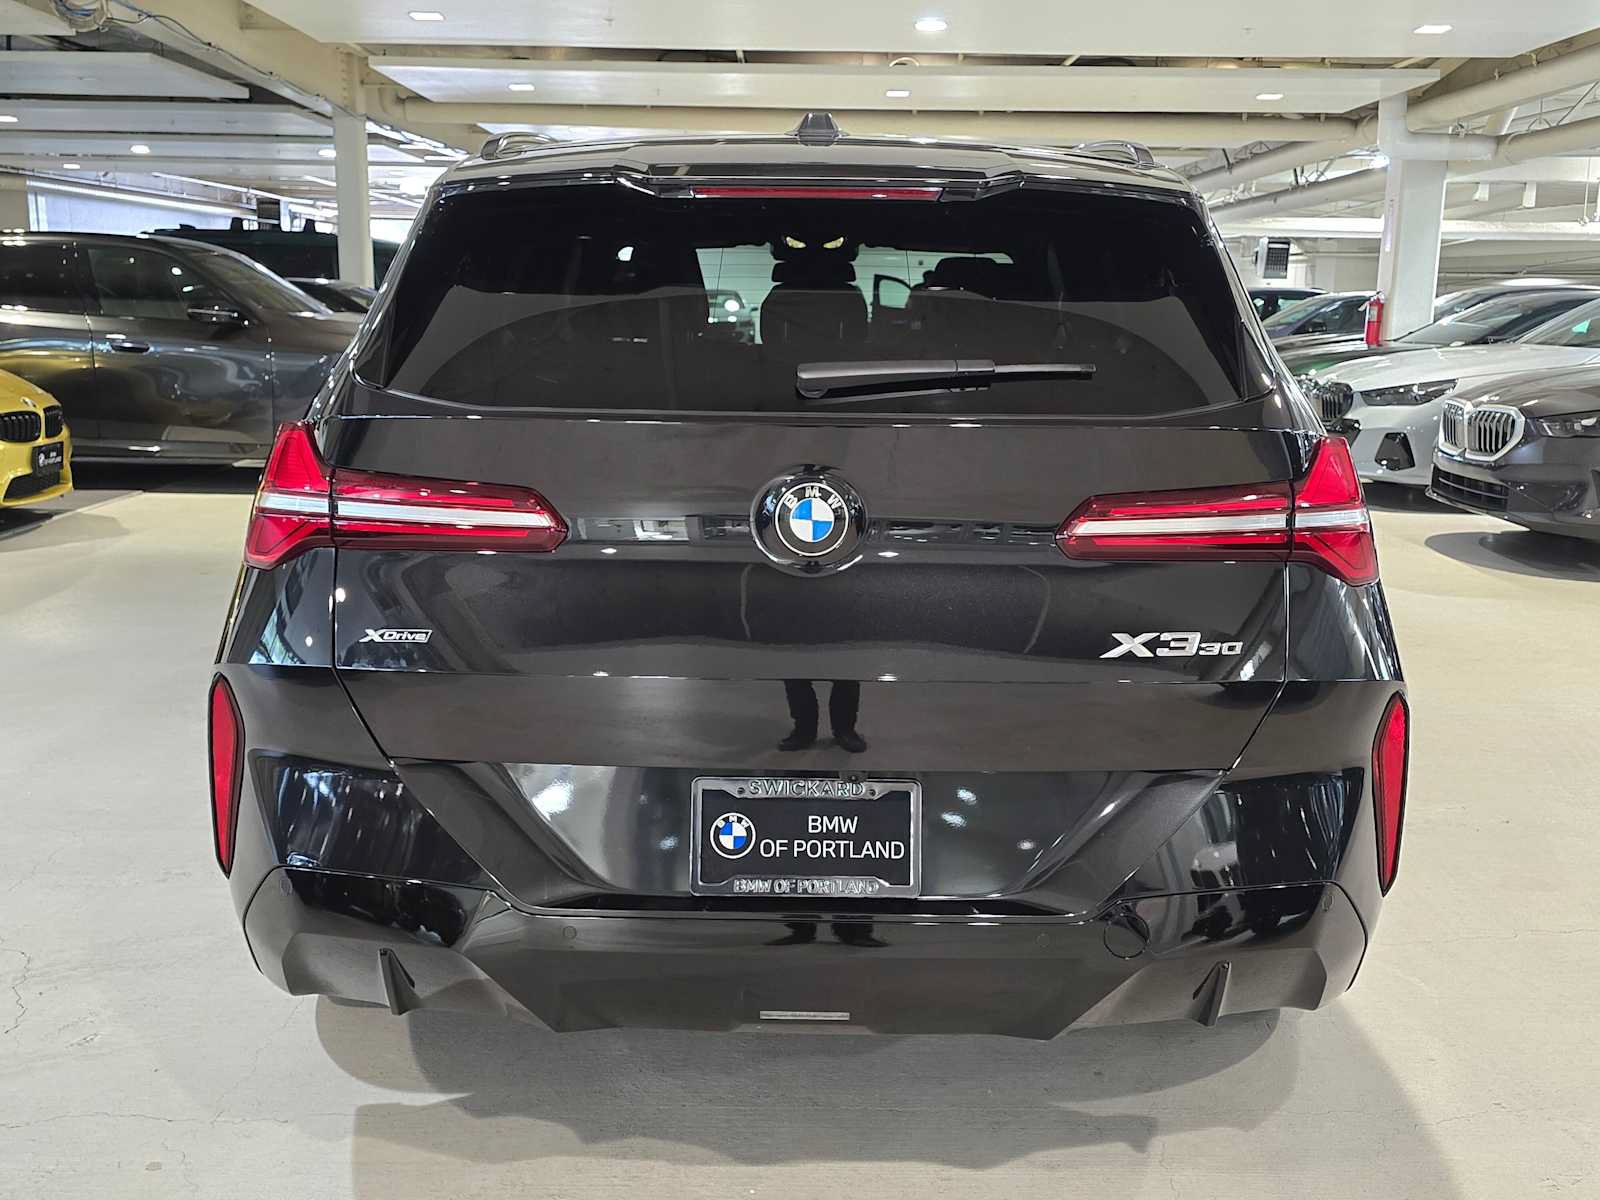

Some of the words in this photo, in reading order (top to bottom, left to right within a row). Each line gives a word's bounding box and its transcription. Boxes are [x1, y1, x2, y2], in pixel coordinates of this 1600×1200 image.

[749, 780, 866, 797] SWICKARD
[808, 816, 858, 833] BMW
[760, 840, 788, 857] OF
[793, 840, 905, 859] PORTLAND
[733, 879, 771, 893] BMW
[774, 879, 795, 893] OF
[798, 879, 879, 894] PORTLAND
